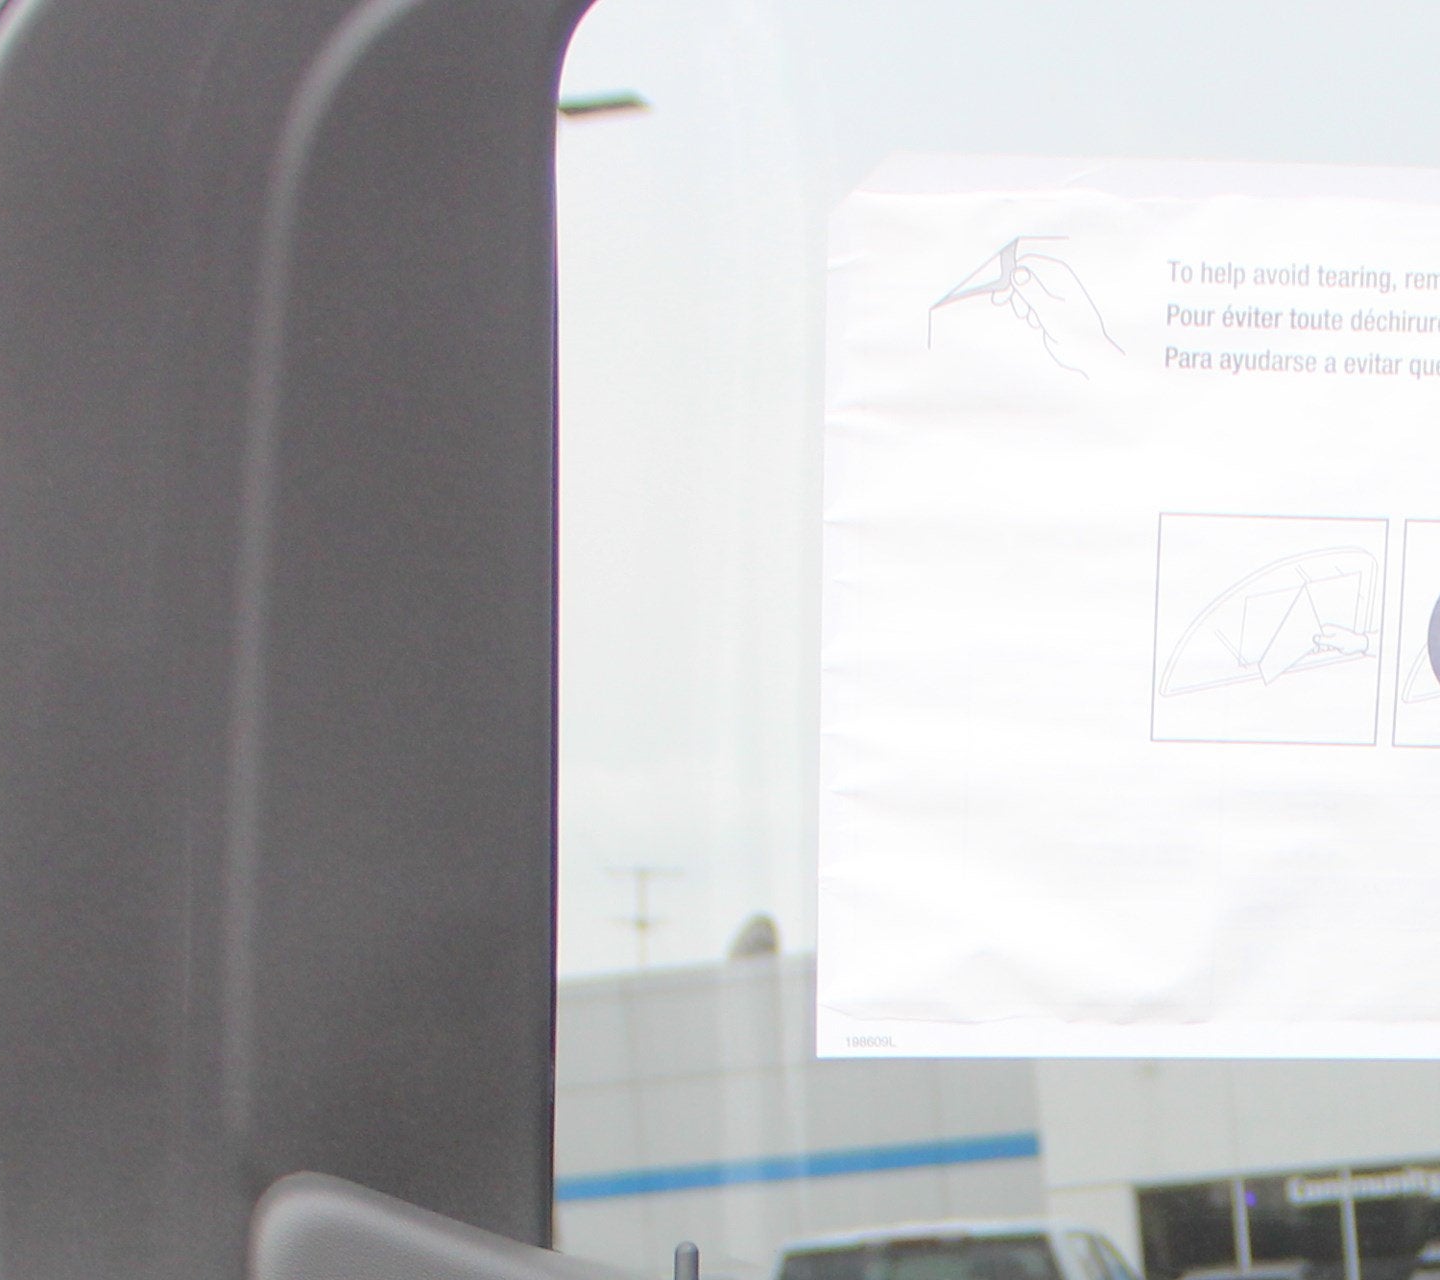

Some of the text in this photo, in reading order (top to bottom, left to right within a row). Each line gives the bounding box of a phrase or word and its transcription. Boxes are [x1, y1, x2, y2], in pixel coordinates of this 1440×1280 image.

[1167, 260, 1193, 283] To
[1200, 261, 1246, 289] help
[1252, 263, 1310, 287] avoid
[1317, 265, 1397, 293] tearing,
[1166, 303, 1215, 327] Pour
[1221, 303, 1283, 329] éviter
[1289, 308, 1343, 331] toute
[1164, 346, 1212, 370] Para
[1219, 349, 1317, 374] ayudarse
[1324, 355, 1337, 374] a
[1343, 353, 1403, 376] evitar
